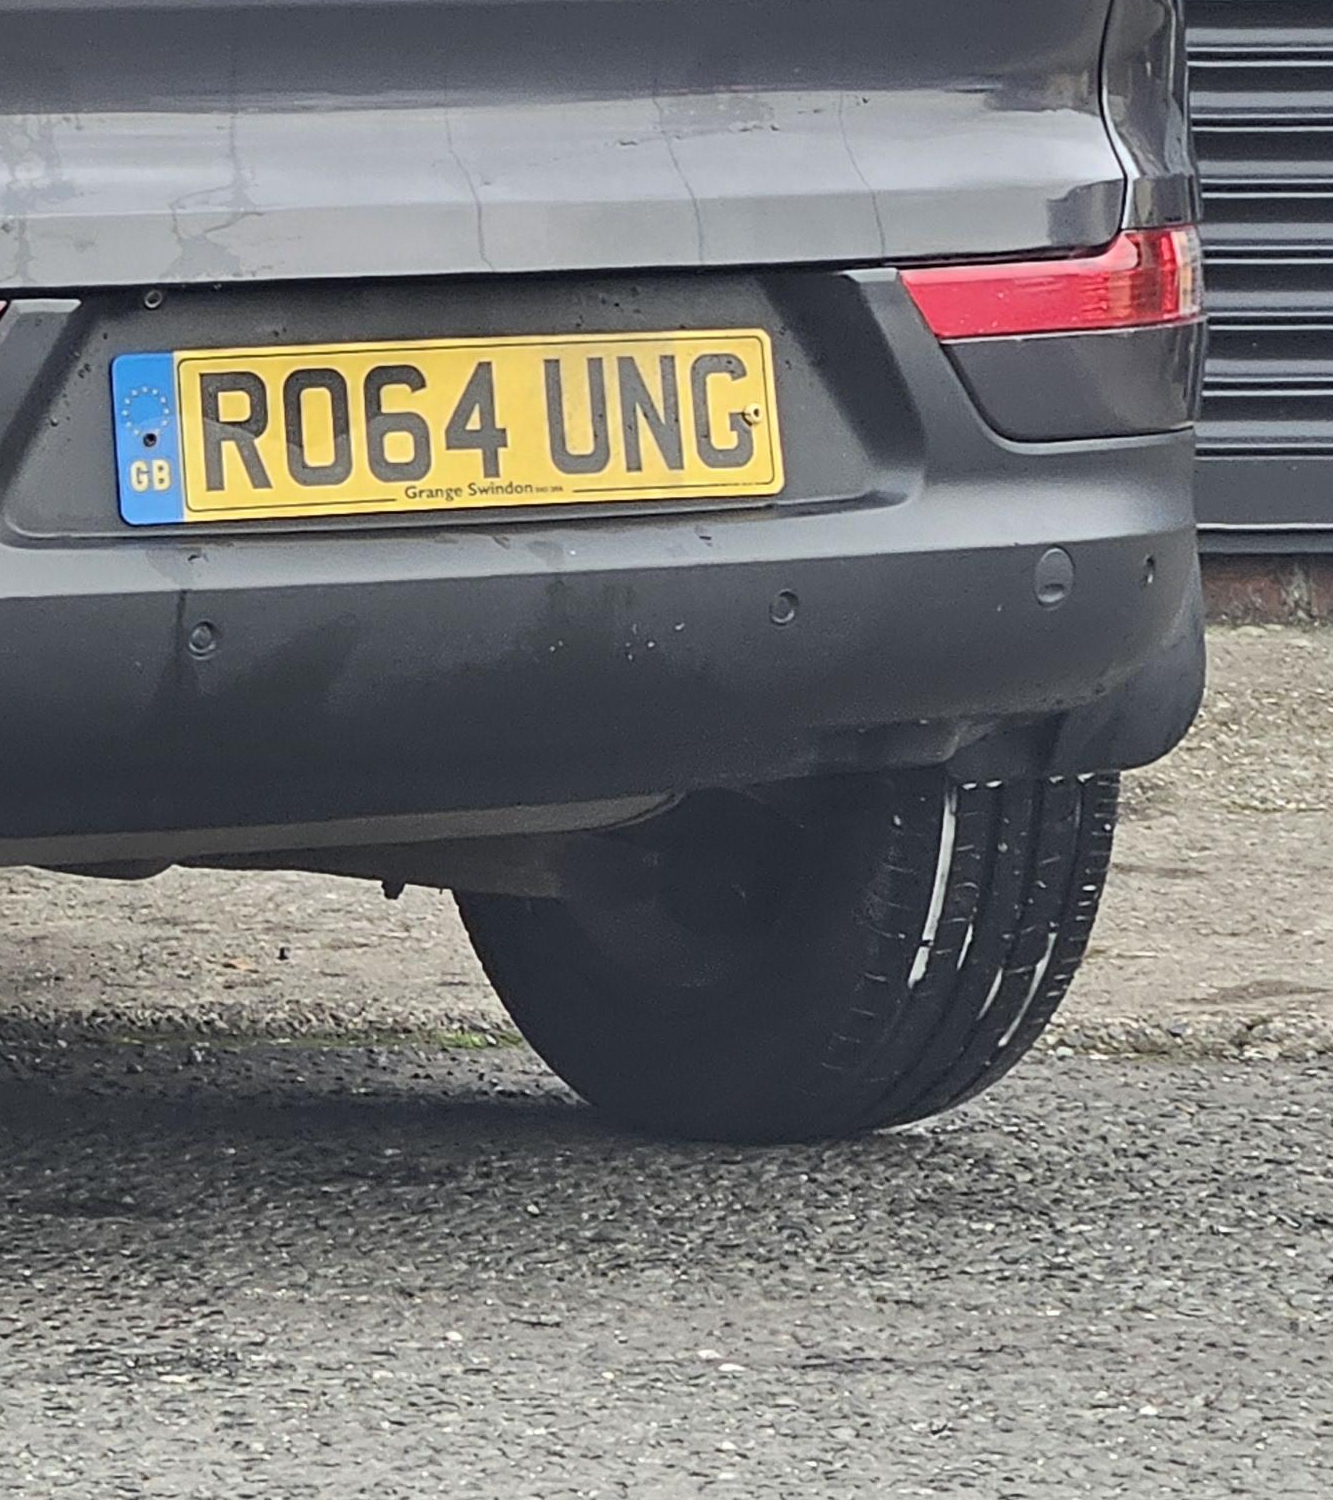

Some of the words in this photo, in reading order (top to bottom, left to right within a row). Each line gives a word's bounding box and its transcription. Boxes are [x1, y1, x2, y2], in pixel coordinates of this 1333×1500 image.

[198, 361, 508, 493] RO64
[543, 352, 755, 476] UNG
[130, 458, 172, 493] GB
[405, 484, 463, 501] Grange
[468, 481, 534, 497] Swindon
